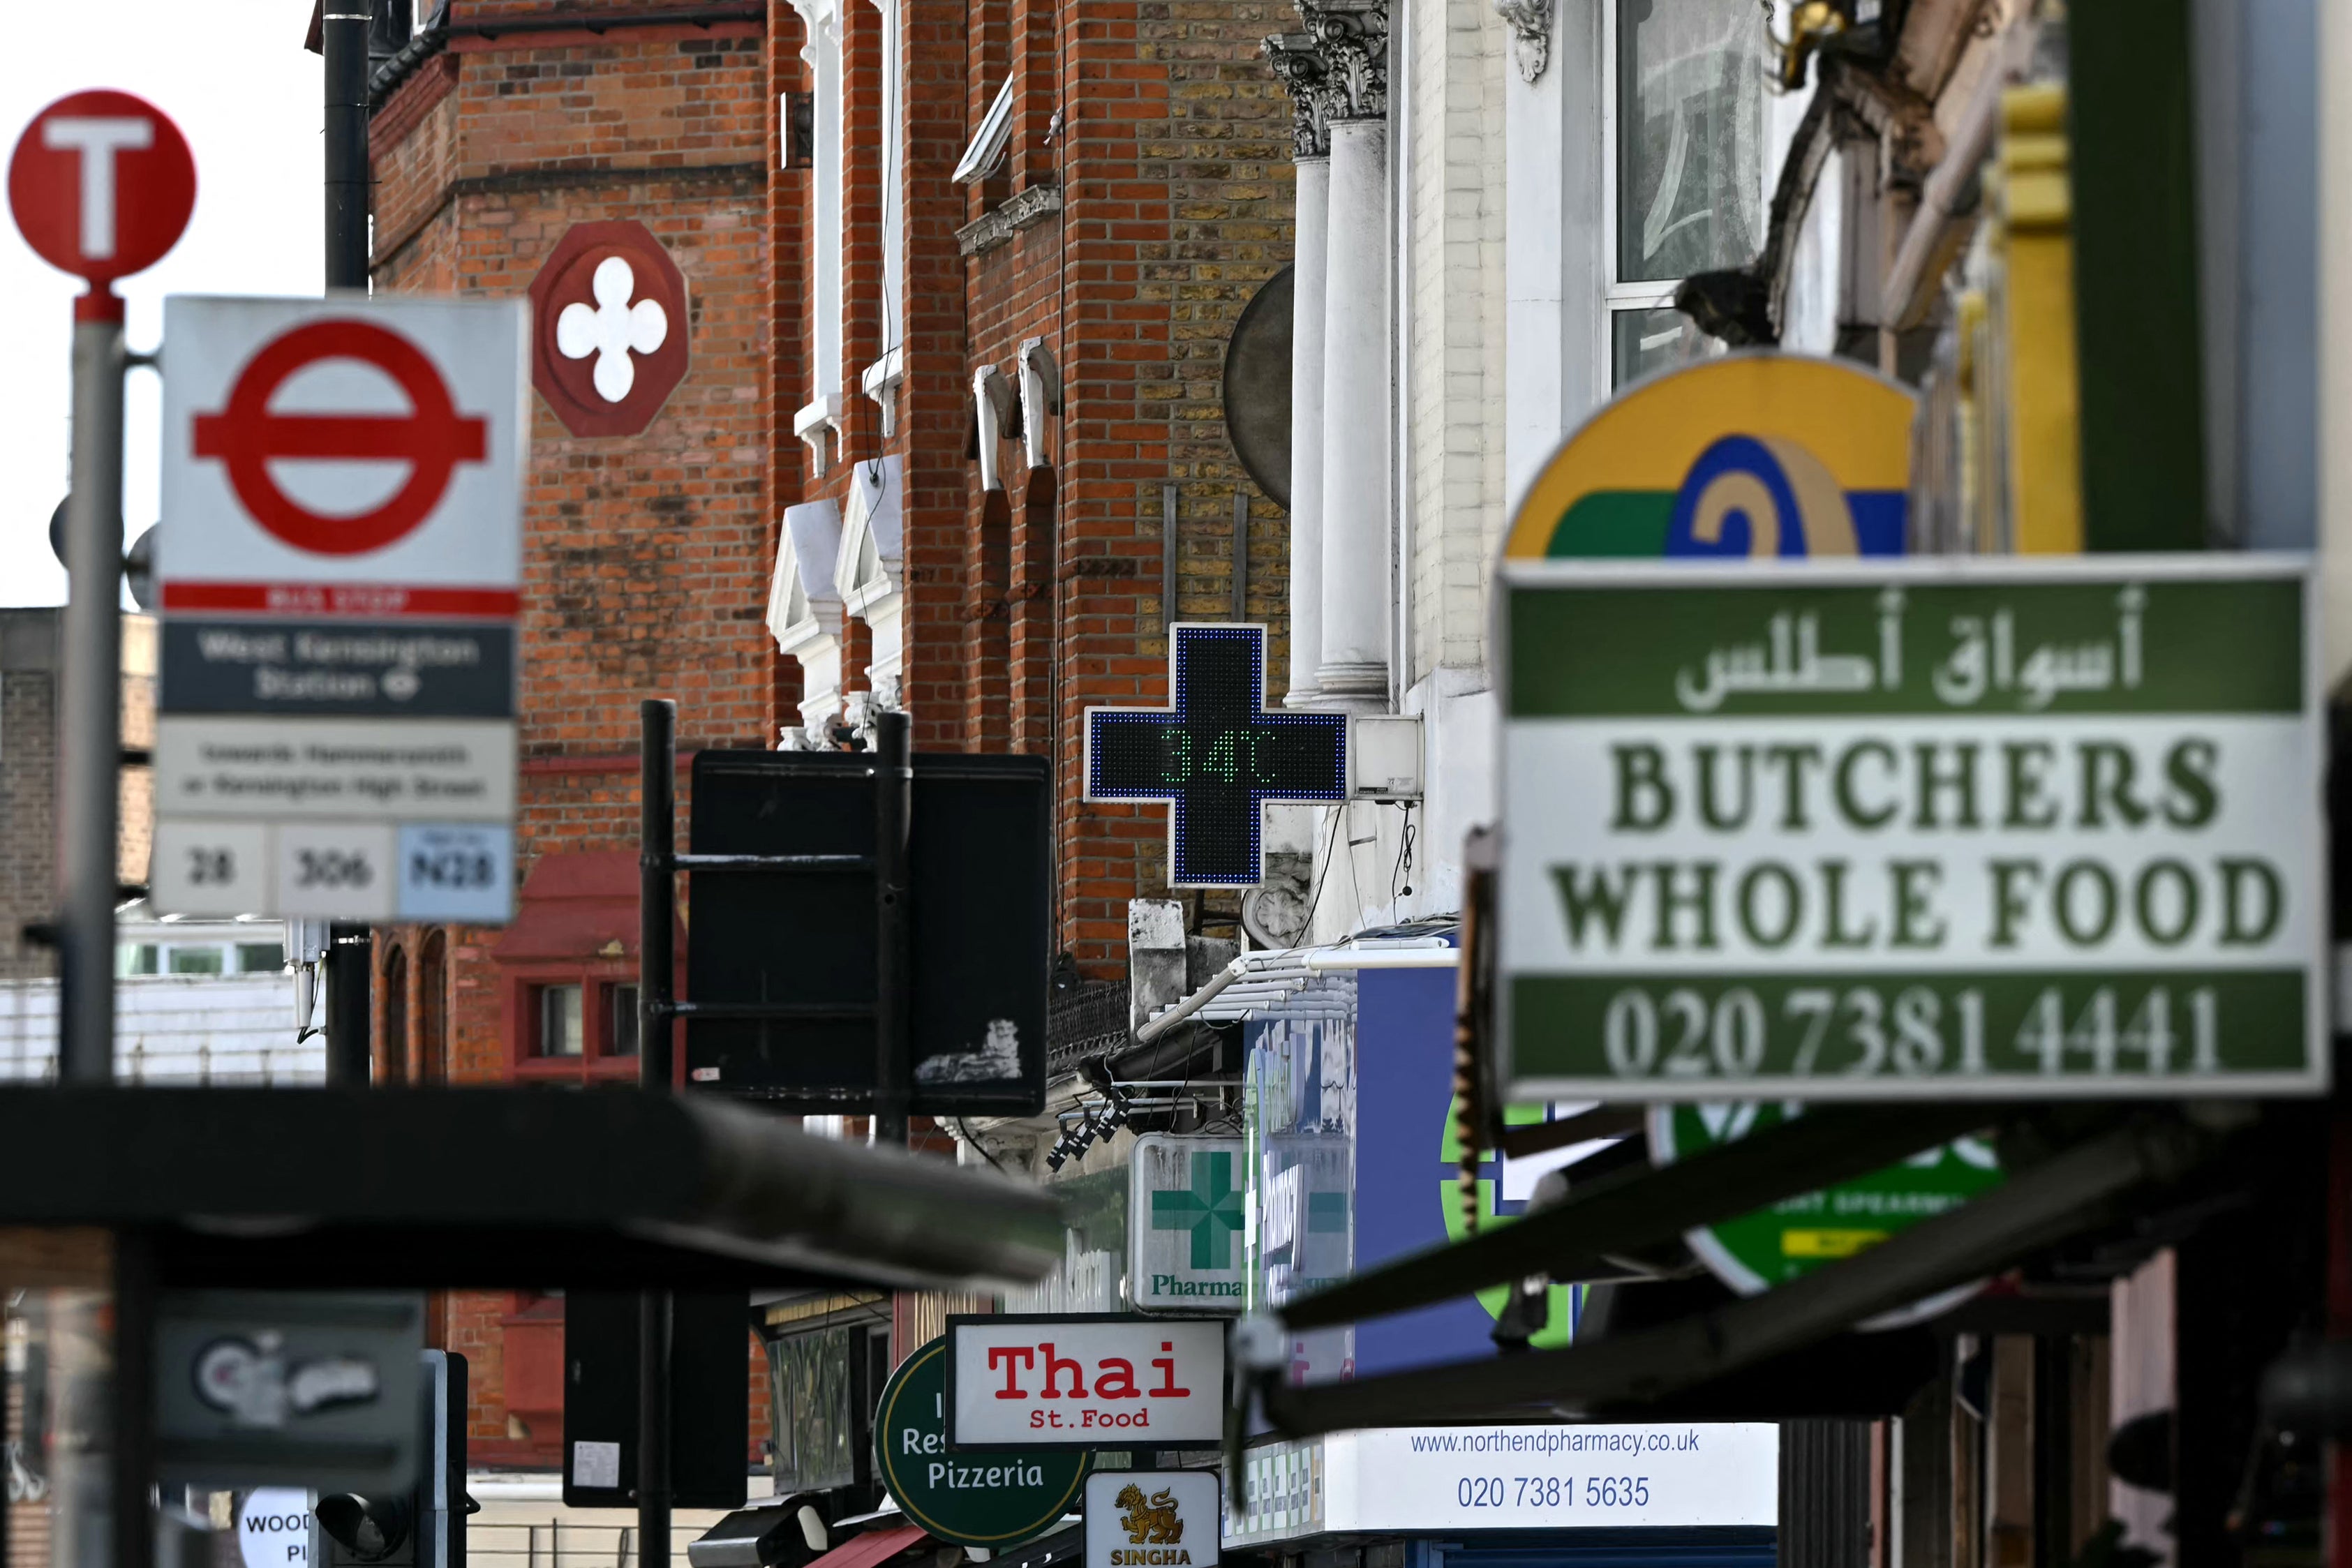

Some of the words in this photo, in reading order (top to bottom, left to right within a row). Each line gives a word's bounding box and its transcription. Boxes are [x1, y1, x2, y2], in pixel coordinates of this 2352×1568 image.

[43, 117, 154, 261] T
[198, 632, 285, 662] West
[294, 632, 479, 670] Kensington
[1935, 586, 2144, 709] أسواق
[254, 666, 376, 699] Station
[1609, 736, 2222, 832] BUTCHERS
[187, 846, 235, 886] 28
[297, 849, 374, 888] 306
[411, 851, 496, 888] N28
[1548, 859, 1947, 951] WHOLE
[1987, 858, 2287, 950] FOOD
[1606, 988, 1766, 1077] 020
[1783, 986, 1989, 1076] 7381
[2015, 986, 2219, 1075] 4441
[988, 1342, 1190, 1399] Thai
[1411, 1429, 1699, 1457] www.northendpharmacy.co.uk
[929, 1459, 1043, 1489] Pizzeria
[1458, 1477, 1505, 1507] 020
[1514, 1477, 1574, 1507] 7381
[1586, 1477, 1649, 1507] 5635
[1110, 1548, 1191, 1565] SINGHA
